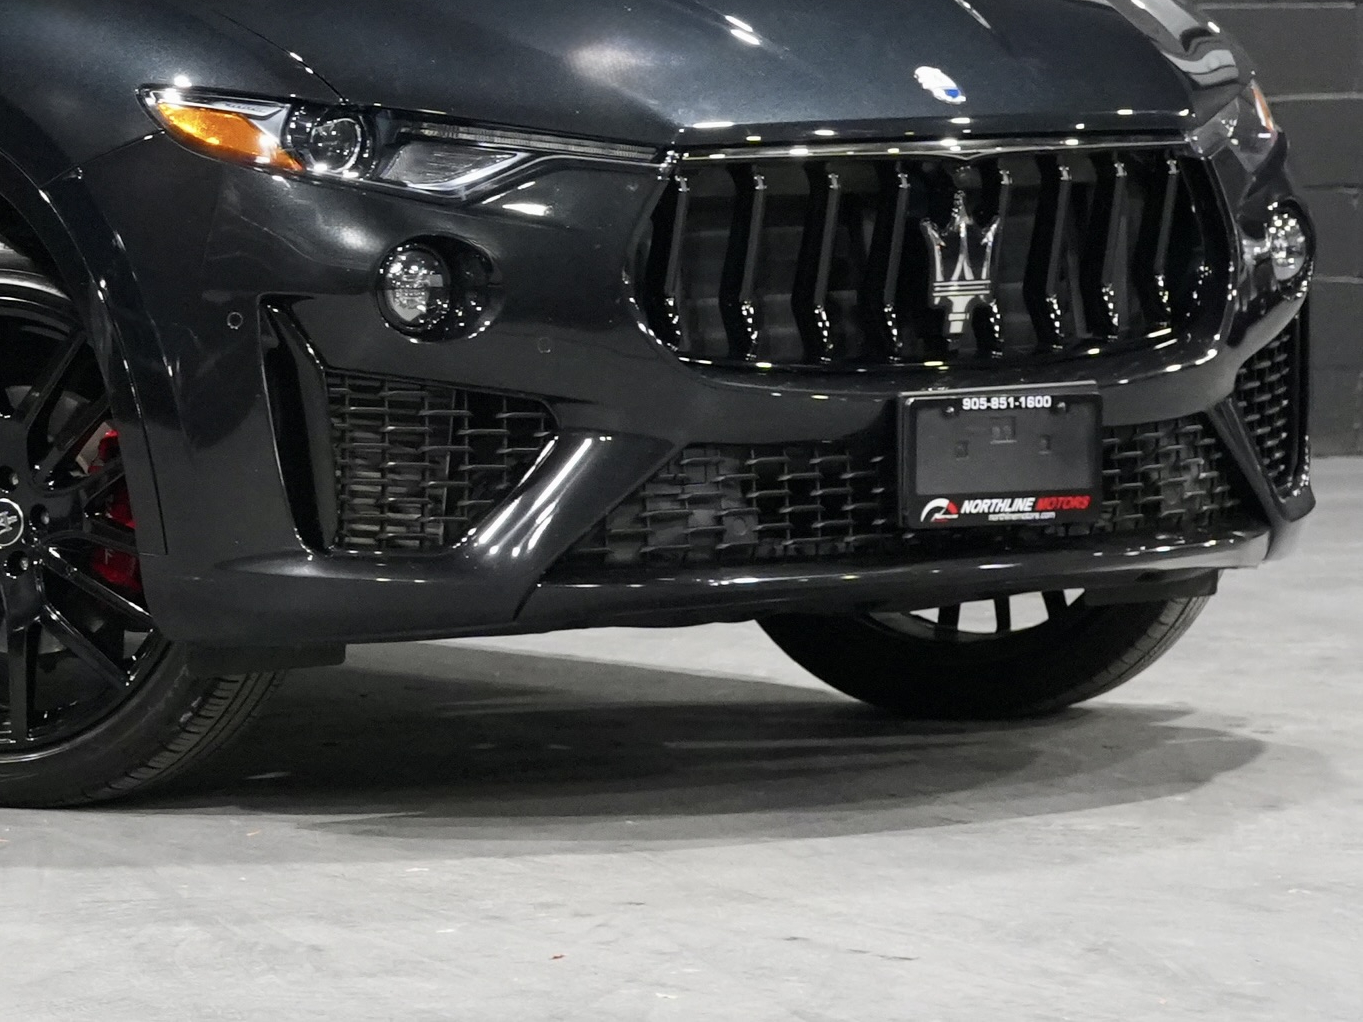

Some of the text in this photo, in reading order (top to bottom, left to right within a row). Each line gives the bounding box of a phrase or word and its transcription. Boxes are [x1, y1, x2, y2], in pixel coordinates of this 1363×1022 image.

[962, 395, 1052, 411] 905-851-1600
[960, 495, 1091, 514] NORTHLINE MOTORS
